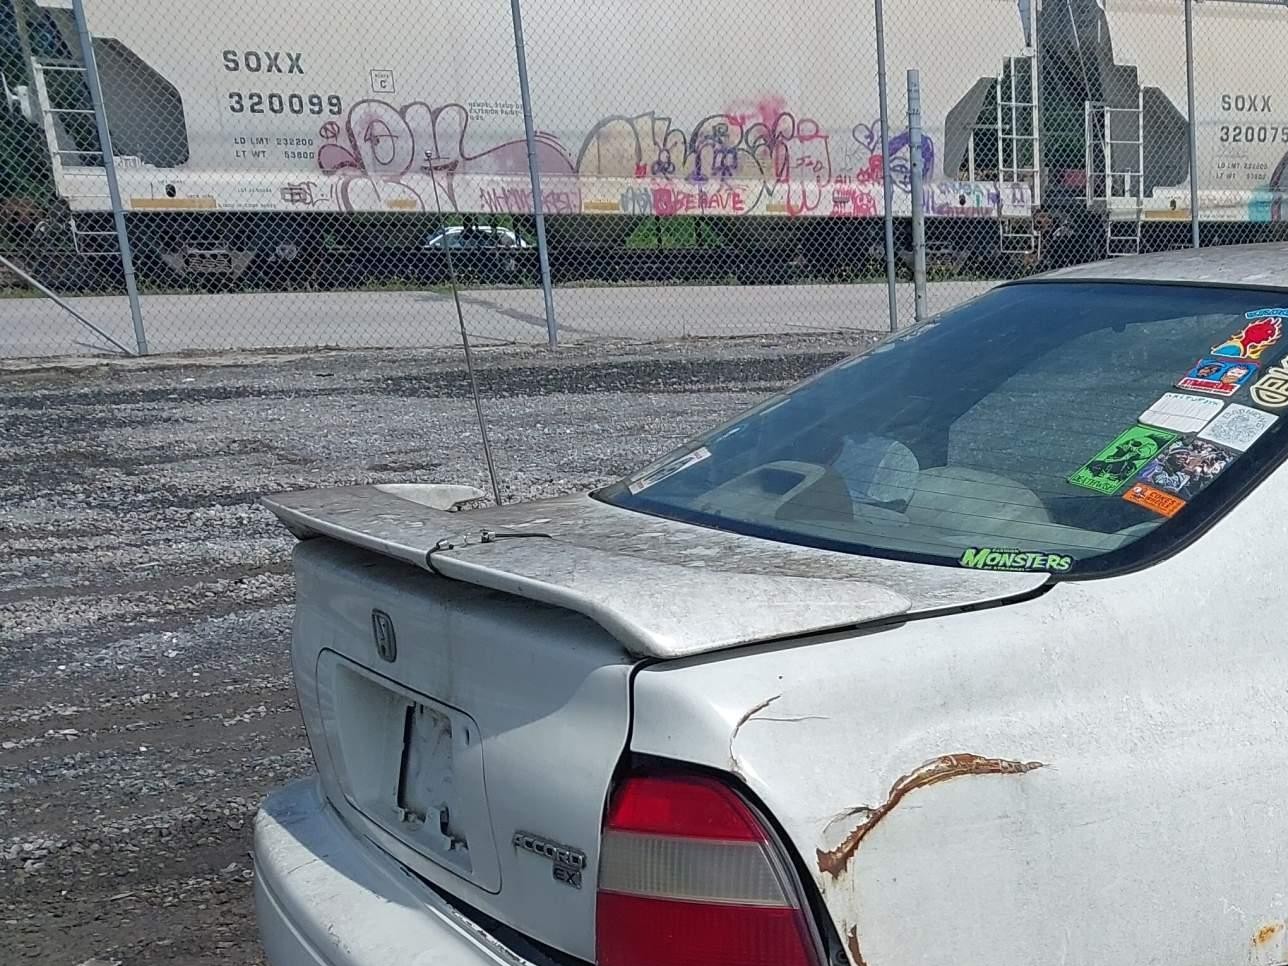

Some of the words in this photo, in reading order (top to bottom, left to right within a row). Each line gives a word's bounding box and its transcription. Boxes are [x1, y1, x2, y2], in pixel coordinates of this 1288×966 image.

[223, 50, 304, 74] SOXX
[228, 92, 342, 115] 320099
[1221, 94, 1271, 112] SOXX
[961, 548, 1071, 571] MONSTERS
[513, 832, 586, 868] ACCORD
[553, 866, 582, 889] EX
